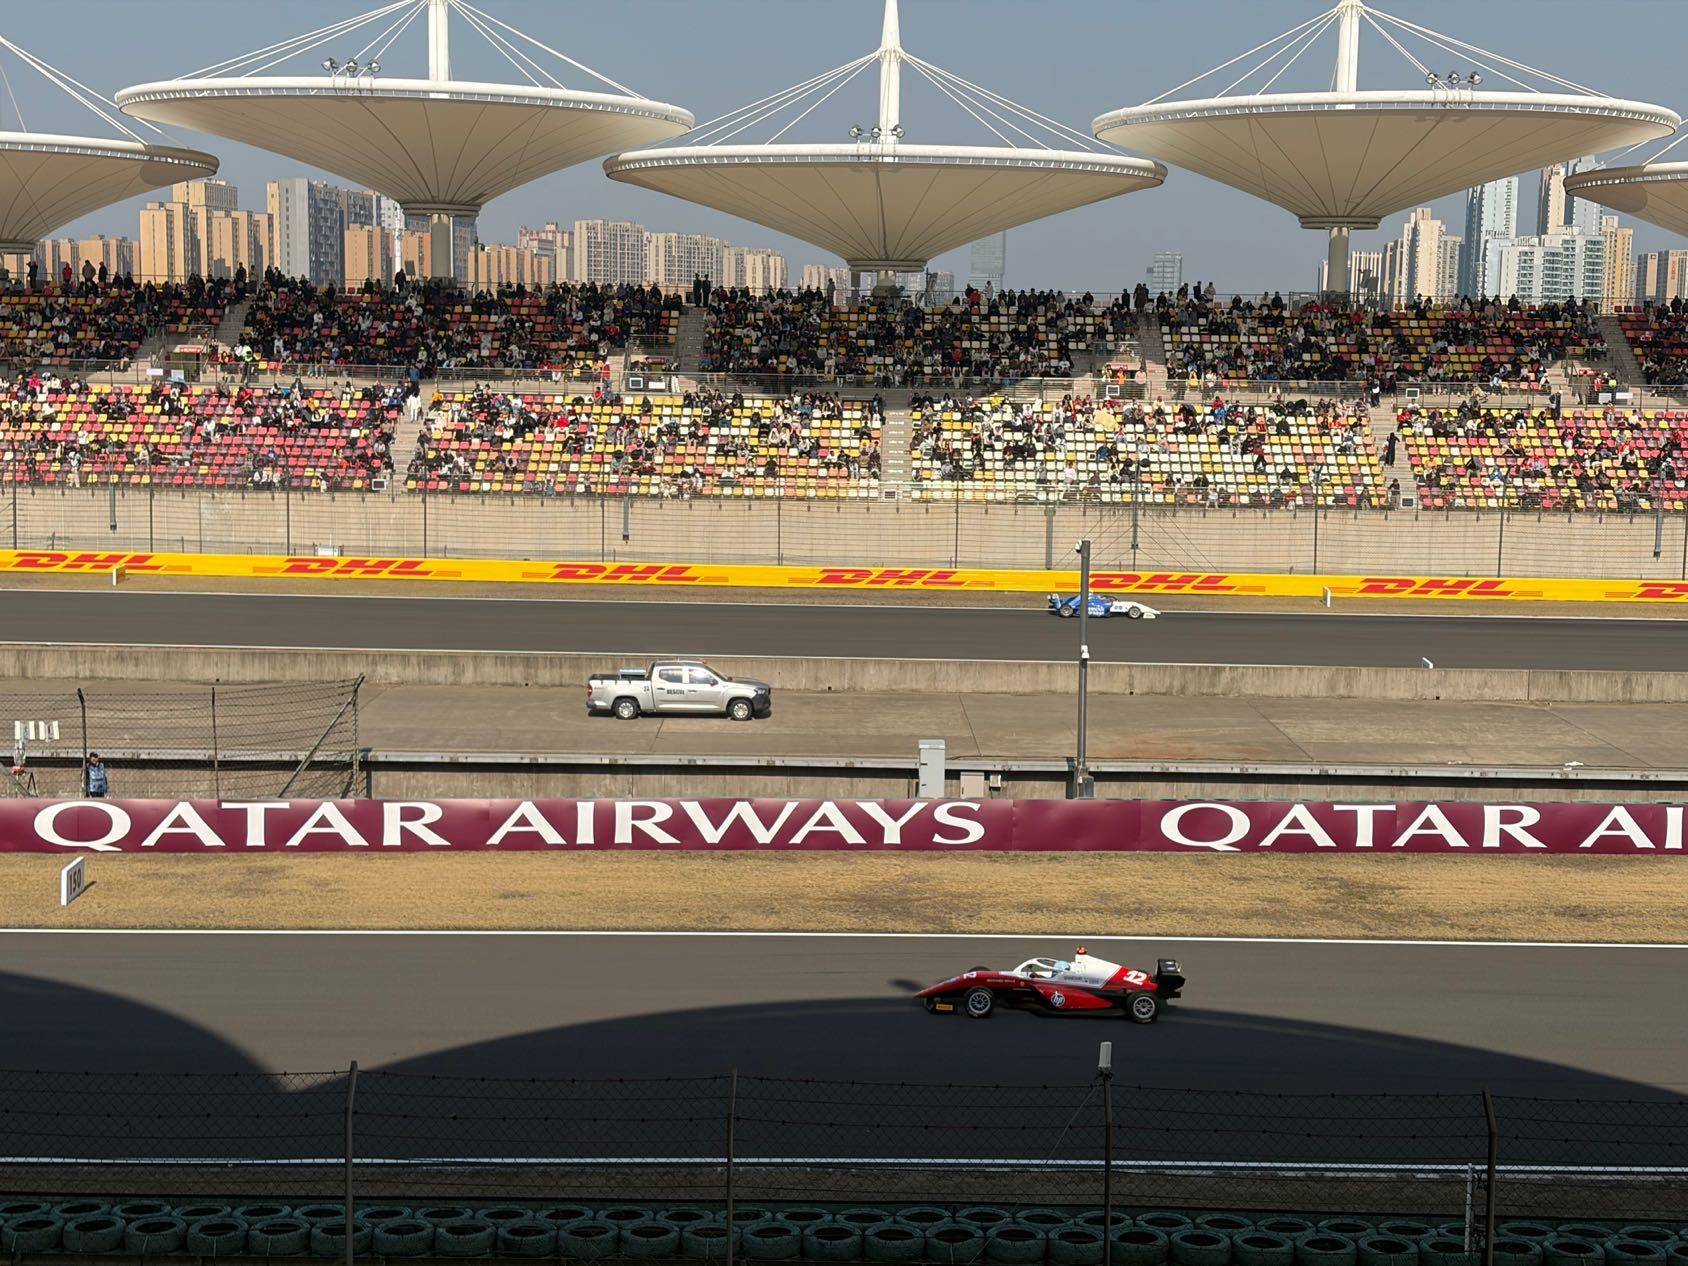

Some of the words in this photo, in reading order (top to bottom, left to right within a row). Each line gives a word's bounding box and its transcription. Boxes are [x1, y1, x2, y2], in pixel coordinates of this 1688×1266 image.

[12, 552, 163, 571] DHL
[283, 558, 433, 577] DHL
[550, 563, 700, 582] DHL
[816, 568, 966, 587] DHL
[1086, 573, 1237, 592] DHL
[1359, 578, 1515, 597] DHL
[33, 800, 451, 852] QATAR
[486, 800, 985, 845] AIRWAYS
[1160, 803, 1547, 852] QATAR
[69, 868, 82, 896] 150
